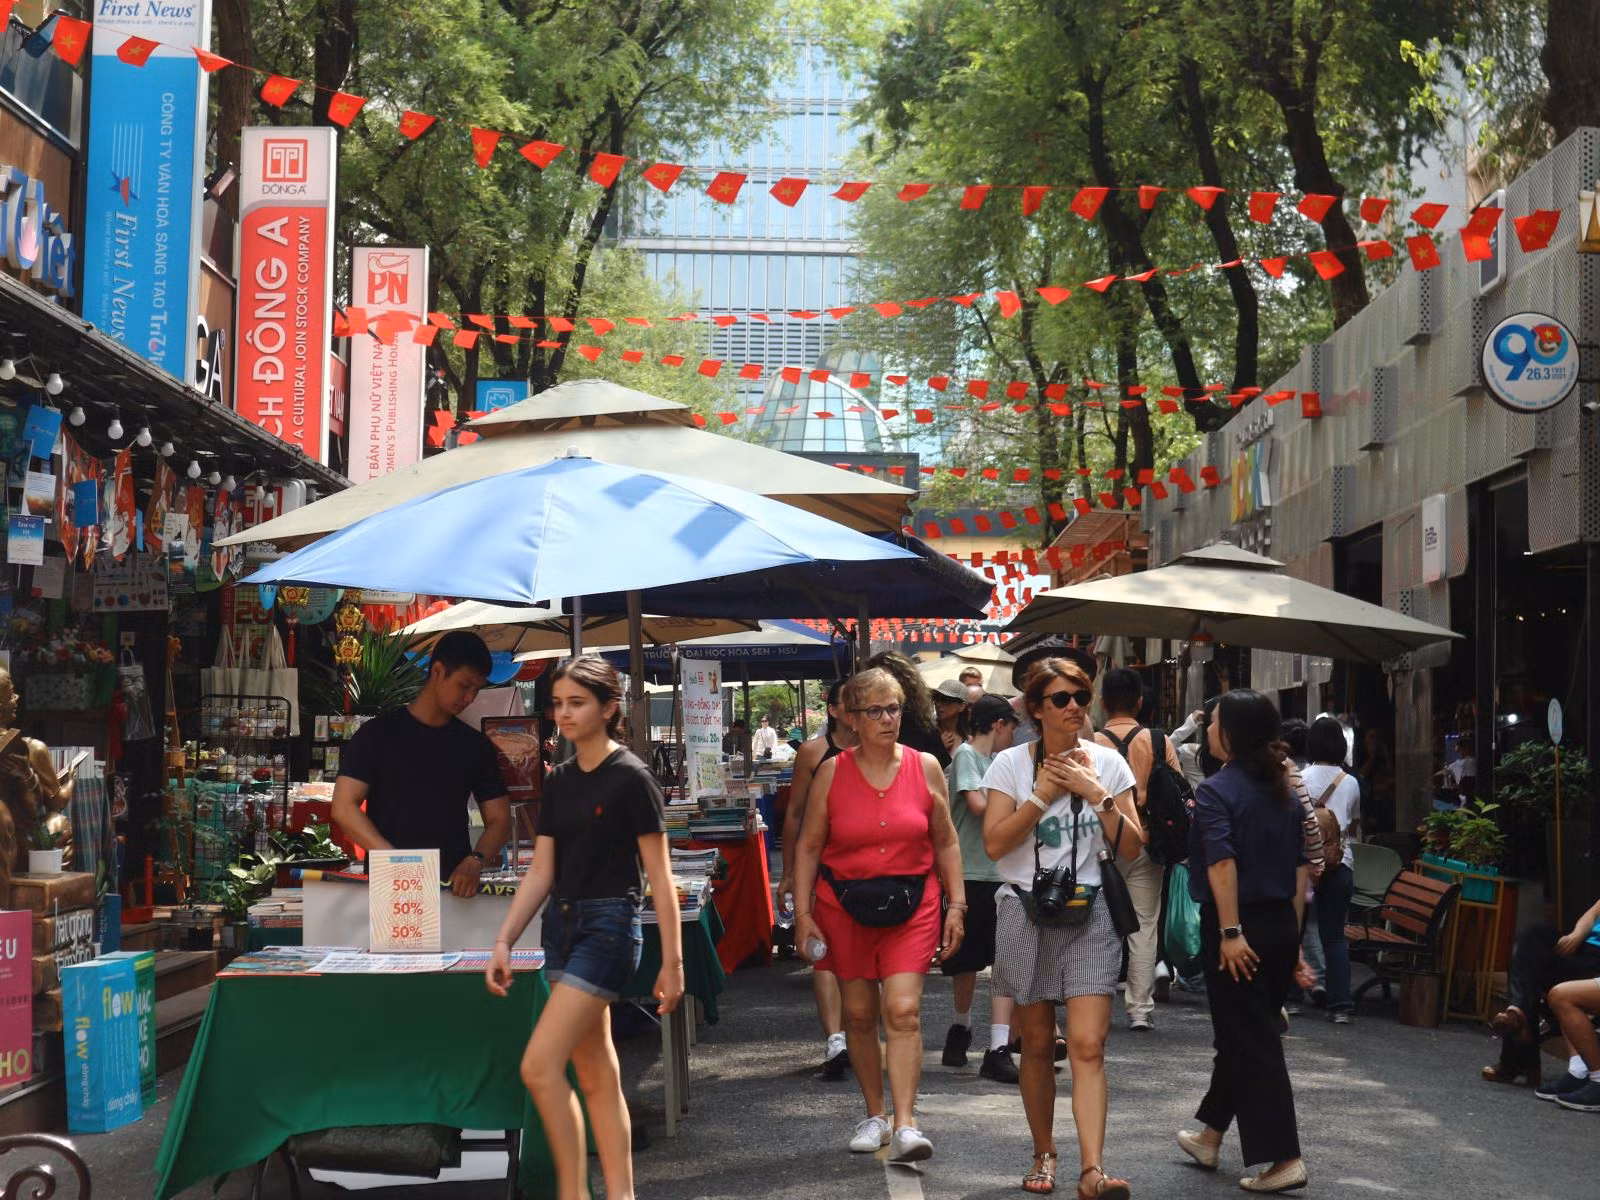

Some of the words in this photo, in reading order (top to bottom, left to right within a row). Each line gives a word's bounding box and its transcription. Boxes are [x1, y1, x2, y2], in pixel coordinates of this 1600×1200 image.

[98, 0, 140, 16] First
[145, 0, 193, 18] News
[114, 211, 138, 270] First
[256, 216, 289, 246] A
[297, 216, 310, 284] COMPANY
[110, 276, 136, 341] News
[246, 257, 289, 384] ĐÔNG
[296, 288, 309, 328] STOCK
[294, 330, 308, 361] JOIN
[373, 337, 383, 359] NA
[388, 334, 398, 368] HOUS
[370, 363, 385, 390] VIỆT
[1526, 368, 1551, 381] 26.3
[293, 364, 306, 426] CULTURAL
[386, 370, 397, 431] PUBLISHING
[370, 414, 383, 441] PHỤ
[386, 435, 396, 473] OMEN'S
[728, 648, 750, 657] HOA
[752, 648, 770, 656] SEN
[778, 647, 798, 655] HSU
[393, 880, 422, 891] 50%
[393, 903, 423, 914] 50%
[392, 926, 422, 938] 50%
